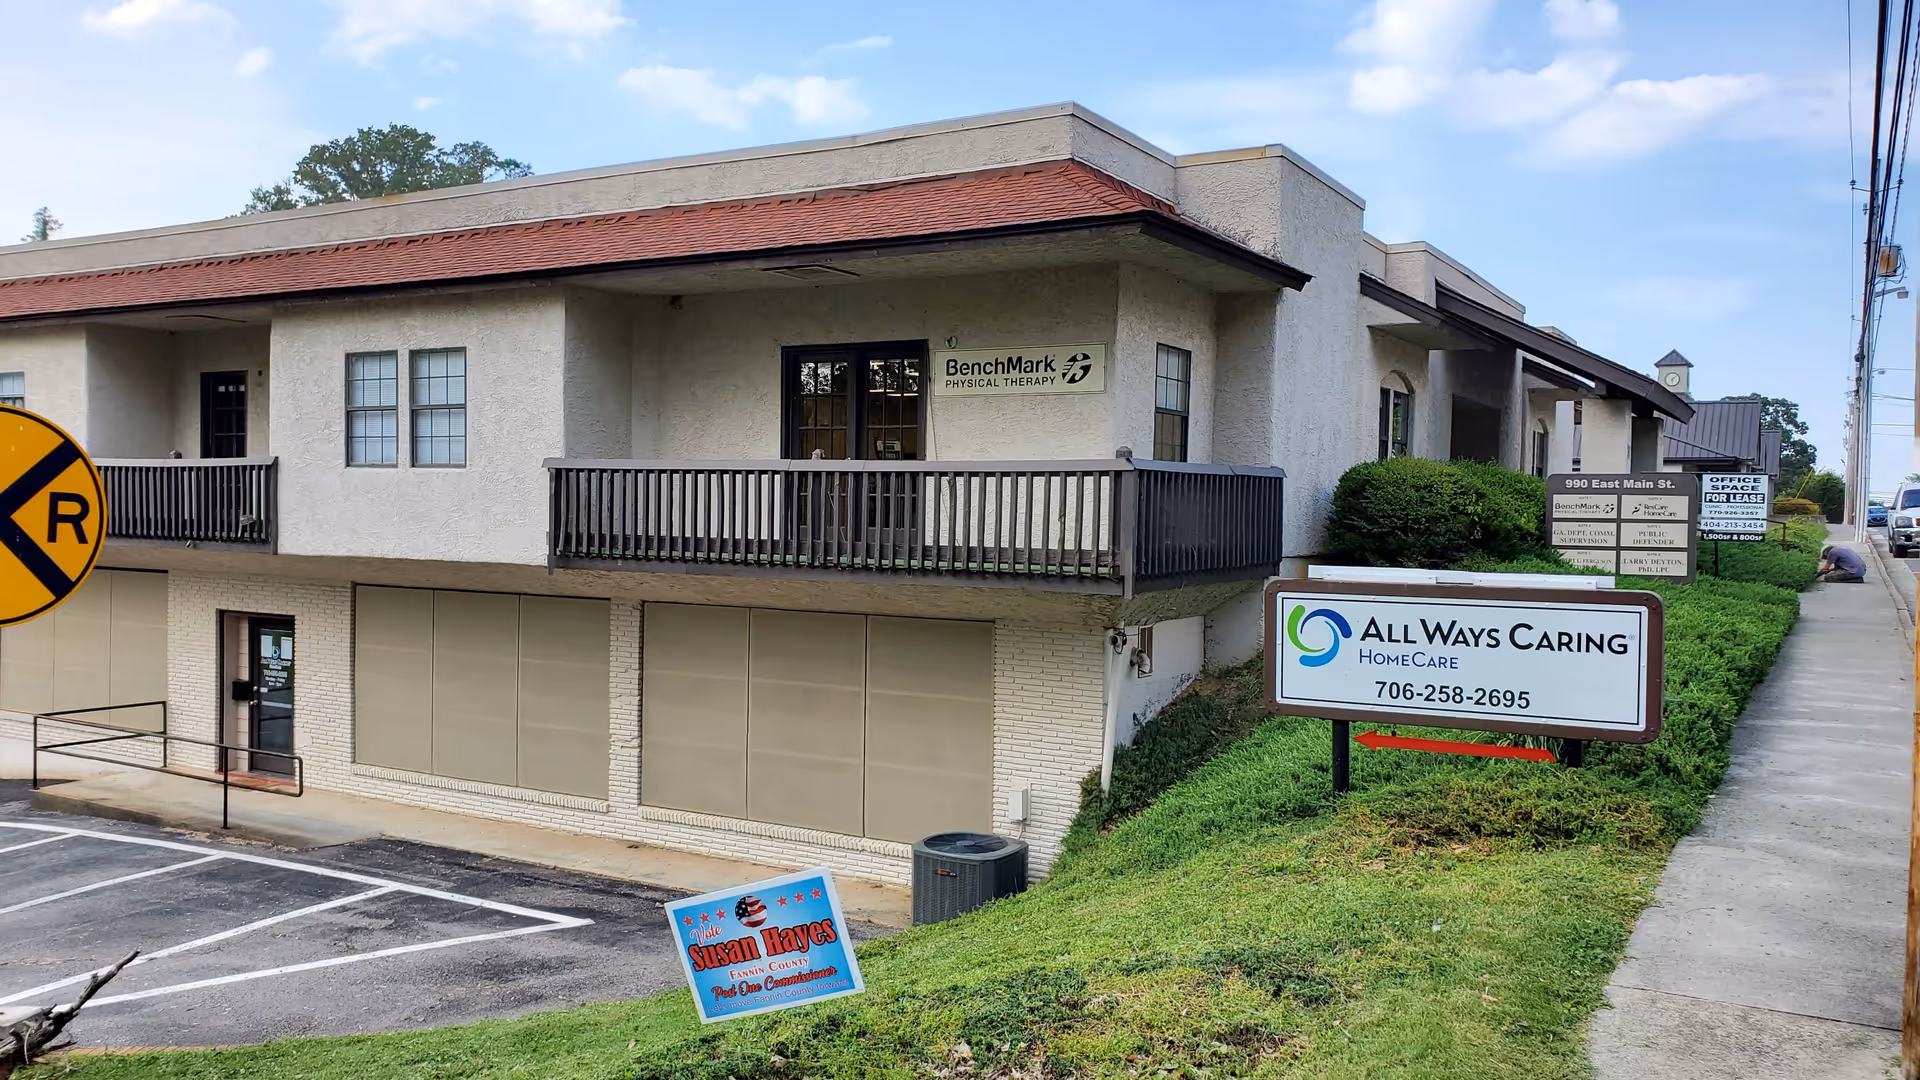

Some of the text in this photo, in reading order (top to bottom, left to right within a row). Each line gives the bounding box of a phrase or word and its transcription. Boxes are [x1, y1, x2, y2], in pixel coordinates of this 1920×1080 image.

[945, 355, 1056, 376] BenchMark
[945, 376, 1056, 388] PHYSICAL THERAPY
[1565, 479, 1676, 489] 990 East Main St.
[1705, 493, 1764, 503] FOR LEASE
[47, 491, 90, 545] R
[1703, 521, 1764, 529] 404-213-3454
[1359, 616, 1417, 643] ALL
[1420, 619, 1500, 649] WAYS
[1374, 681, 1531, 709] 706-258-2695
[688, 918, 838, 972] Susan Hayes
[690, 923, 723, 946] Vote
[729, 957, 809, 980] FANNIN COUNTY
[711, 965, 838, 1001] Post One Commissioner
[730, 999, 752, 1008] move
[754, 991, 782, 1004] Fannin
[784, 985, 815, 998] County
